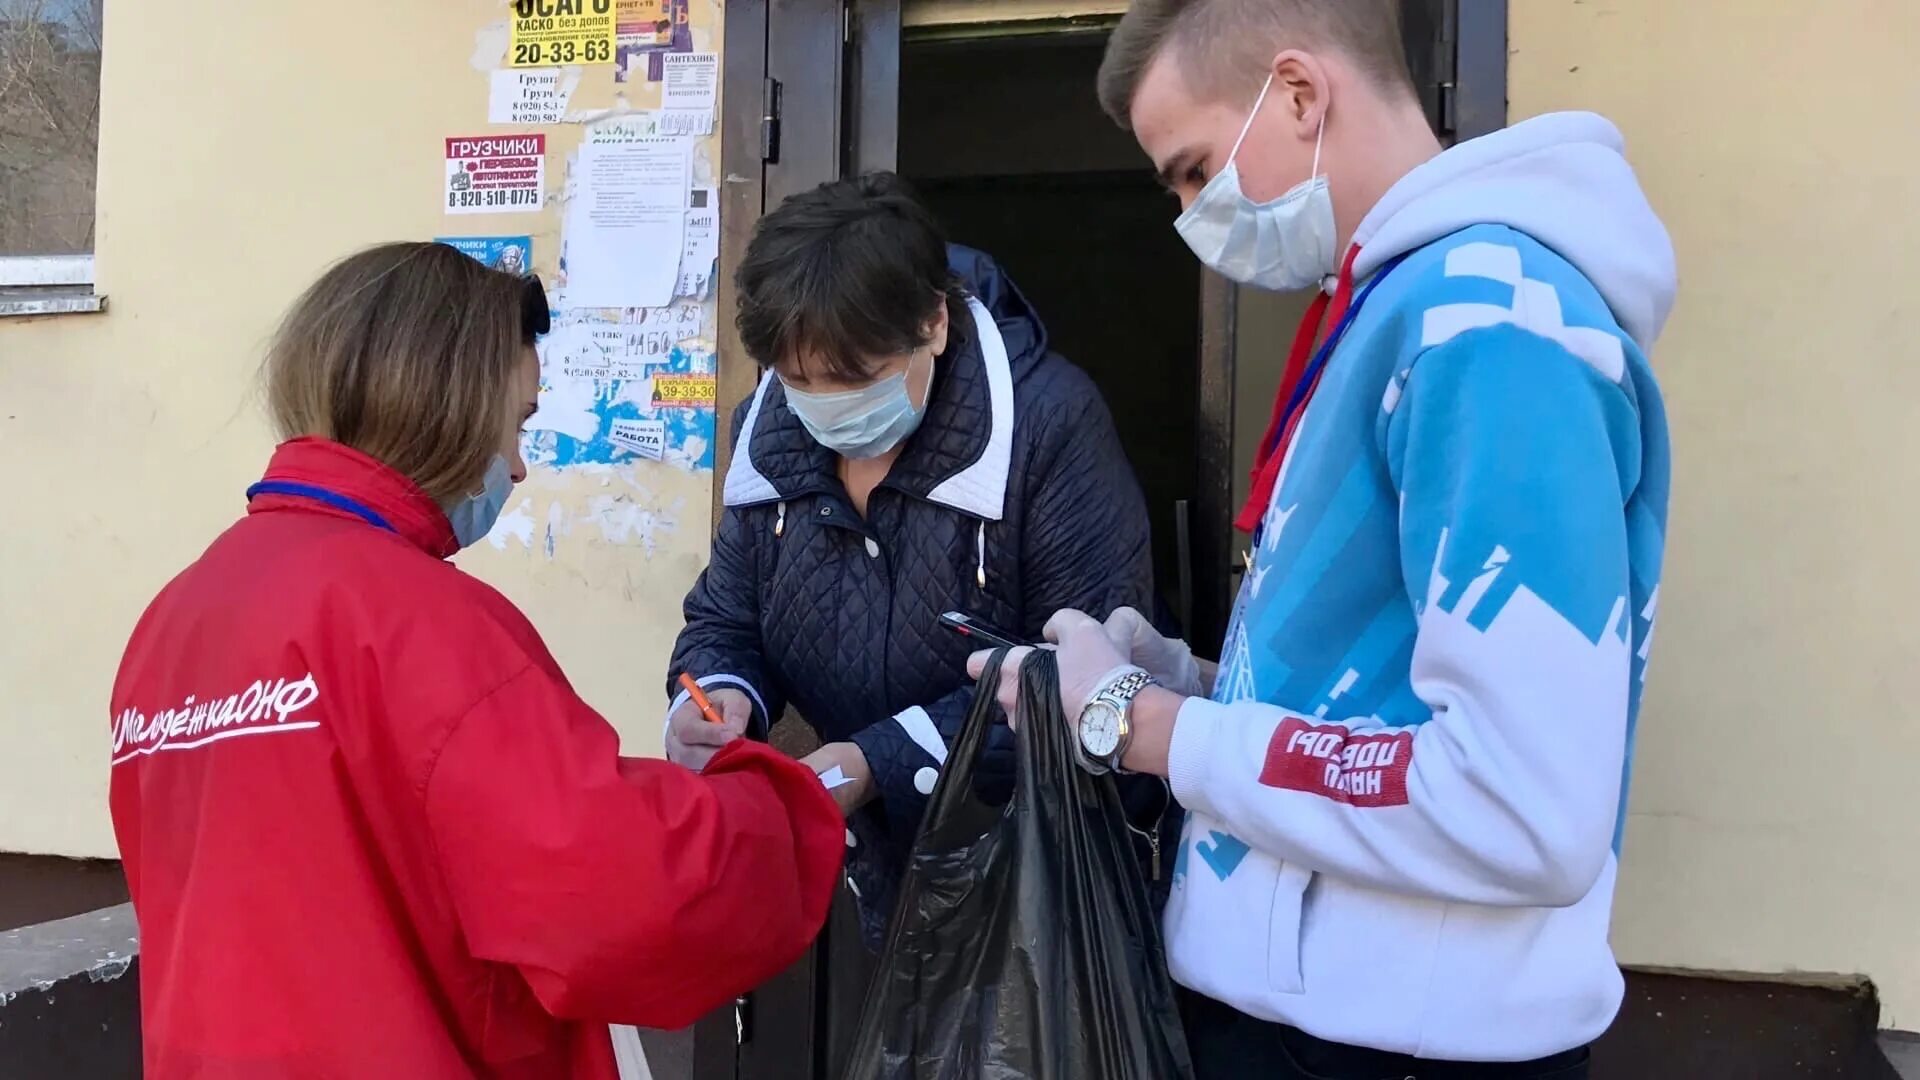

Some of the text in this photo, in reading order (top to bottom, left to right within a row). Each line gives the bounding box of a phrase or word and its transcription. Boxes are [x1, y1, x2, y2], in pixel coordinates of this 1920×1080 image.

[516, 17, 610, 31] КАСКО без допов
[517, 34, 579, 43] ВОССТАНОВЛЕНИЕ
[515, 40, 610, 64] 20-33-63
[664, 55, 715, 63] САНТЕХНИК
[512, 102, 518, 110] 8
[519, 102, 541, 111] (920)
[519, 114, 541, 122] (920)
[450, 138, 538, 157] ГРУЗЧИКИ
[479, 157, 538, 169] ПЕРЕЕЗДЫ
[472, 170, 538, 181] АВТОТРАНСПОРТ
[449, 189, 538, 207] 8-920-510-0775
[663, 386, 715, 397] 39-39-30
[615, 430, 659, 444] РАБОТА
[1286, 730, 1401, 771] ПОБДЫ
